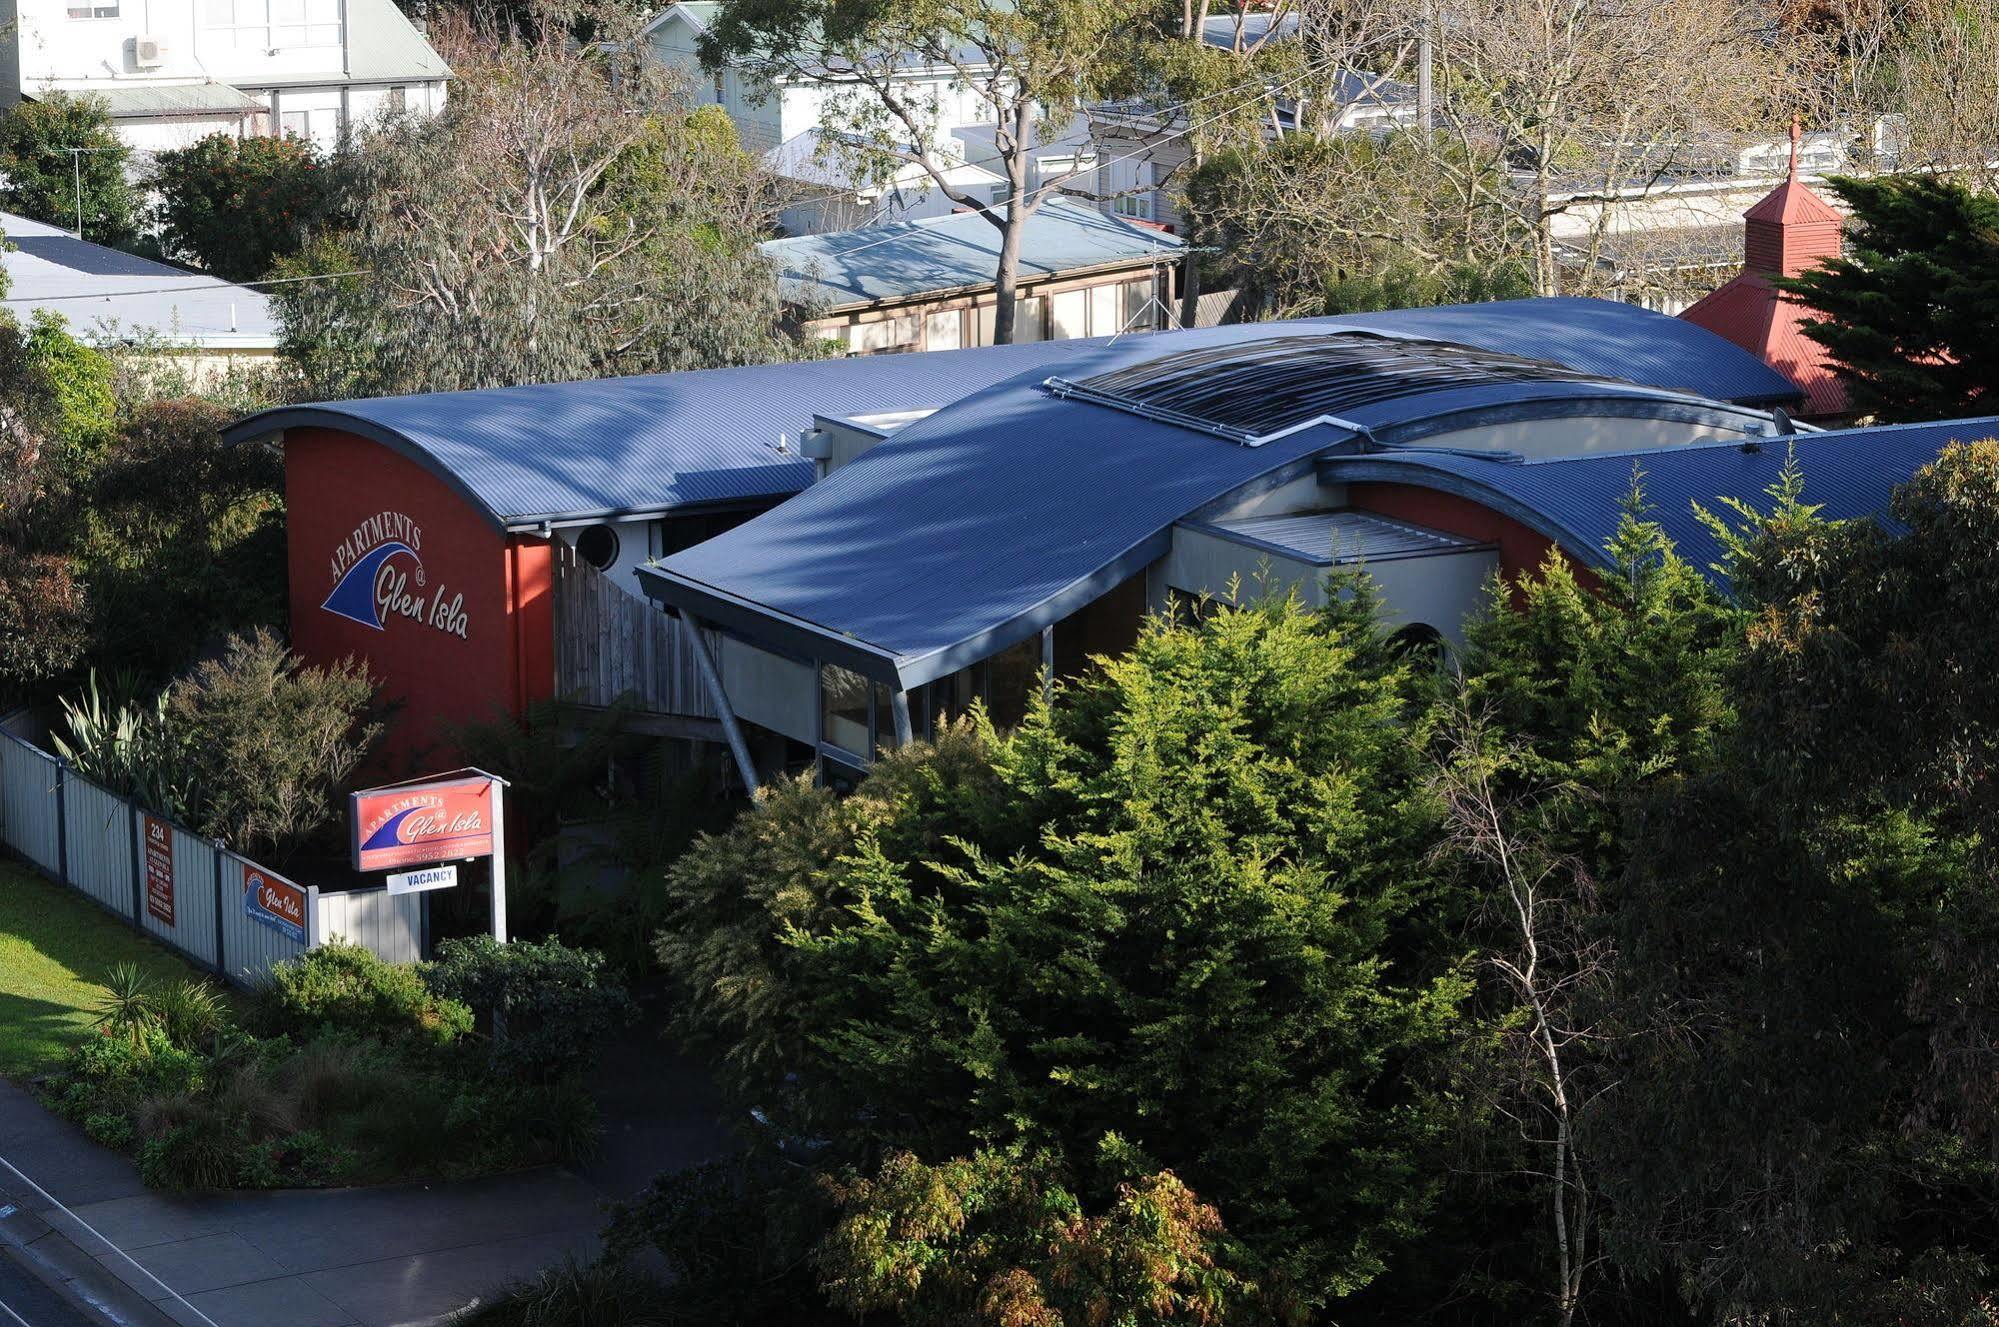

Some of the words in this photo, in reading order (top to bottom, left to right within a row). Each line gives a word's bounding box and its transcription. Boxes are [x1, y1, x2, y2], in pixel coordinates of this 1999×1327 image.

[330, 511, 422, 583] APARTMENTS
[415, 566, 427, 587] @
[376, 564, 425, 623] Glen
[429, 584, 468, 639] Isla
[366, 796, 444, 836] APARTMENTS
[406, 815, 446, 841] Glen
[450, 809, 482, 832] Isla
[434, 809, 447, 820] @
[151, 823, 164, 842] 234
[407, 870, 453, 887] VACANCY
[266, 888, 283, 909] Glen
[284, 896, 299, 917] Isla
